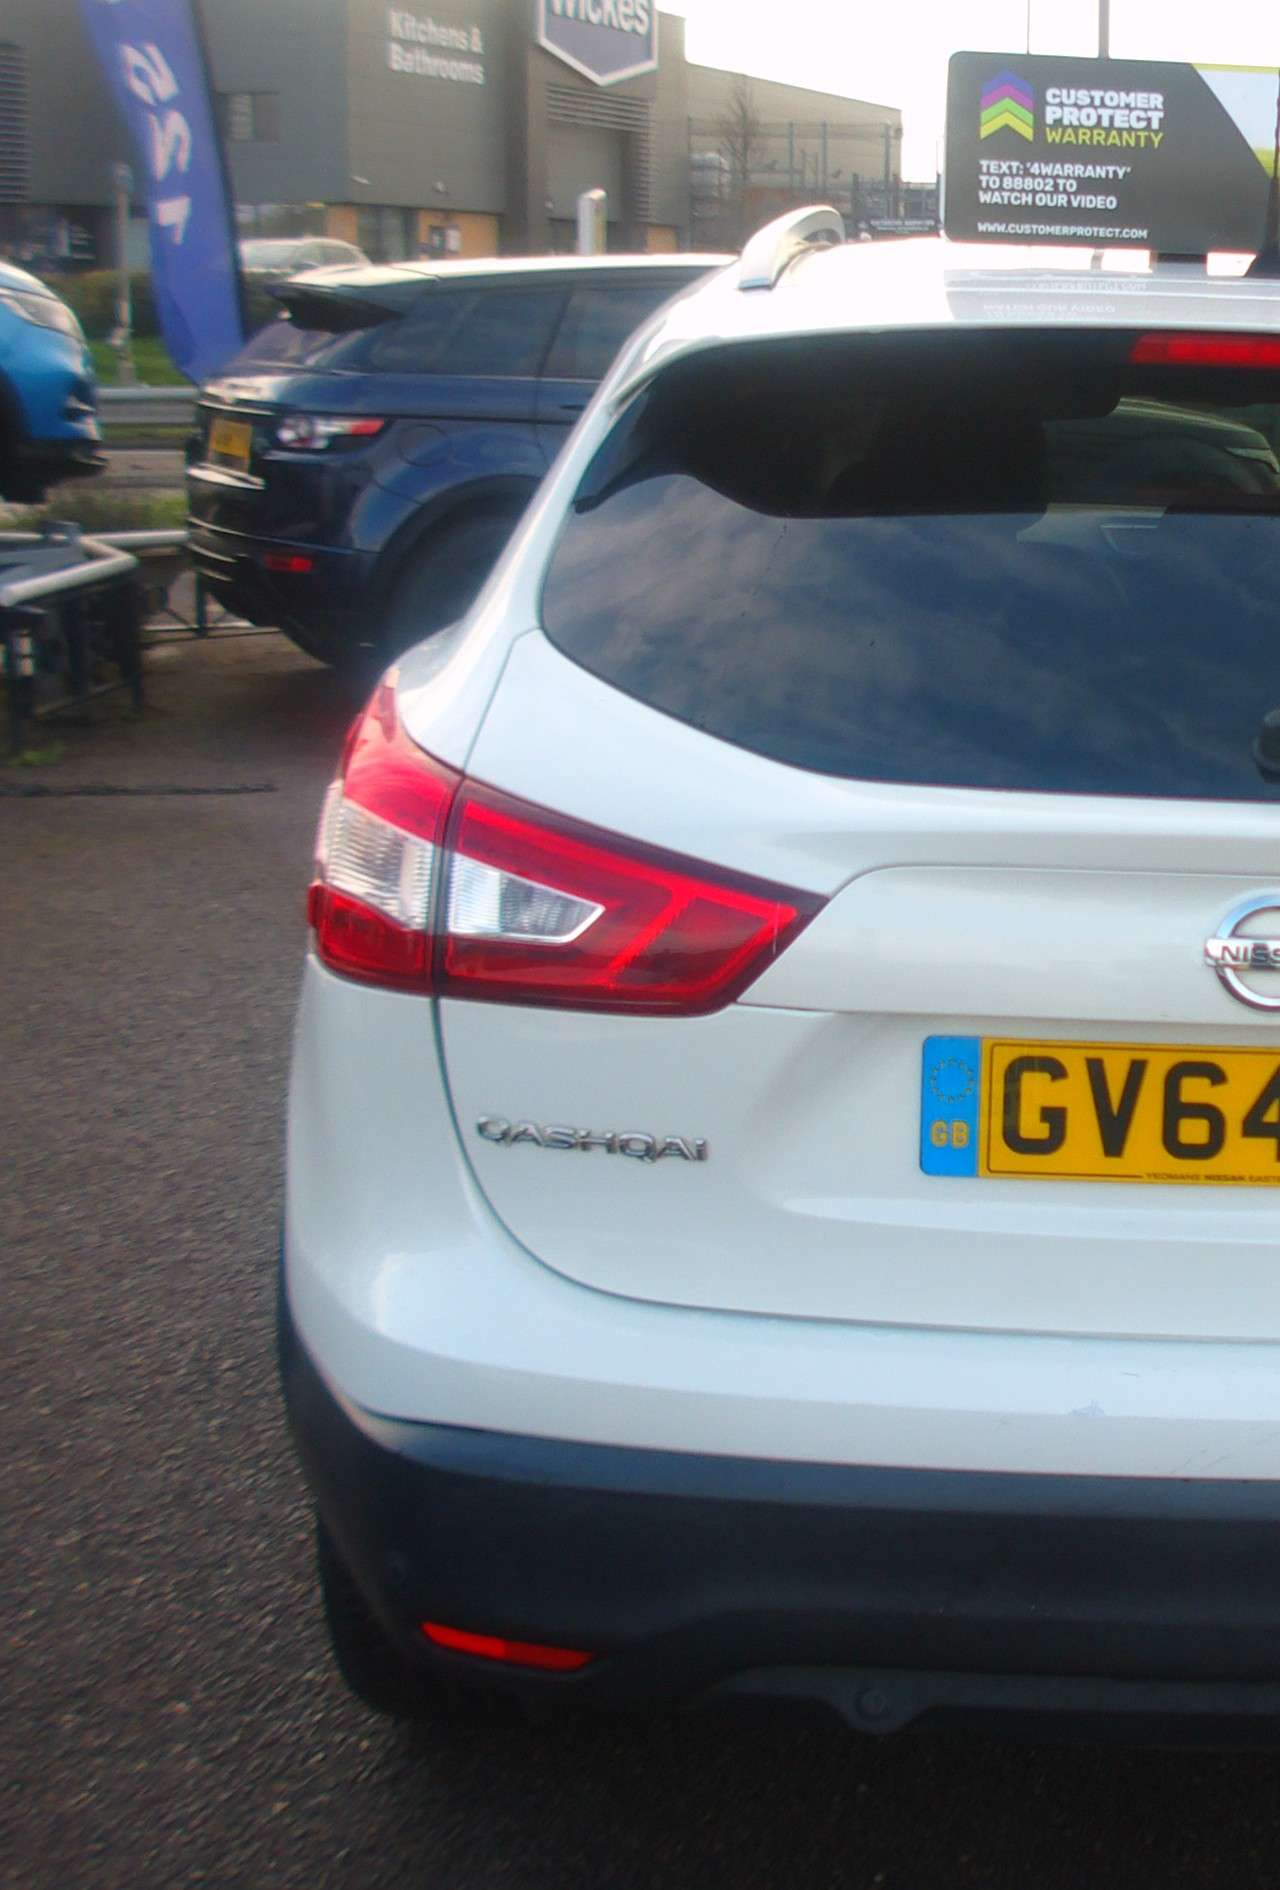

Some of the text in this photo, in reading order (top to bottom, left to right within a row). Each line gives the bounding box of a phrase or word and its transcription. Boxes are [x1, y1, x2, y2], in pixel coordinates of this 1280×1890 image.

[389, 9, 484, 53] Kitchens &
[389, 42, 485, 84] Bathrooms
[1045, 88, 1164, 109] CUSTOMER
[1045, 106, 1164, 130] PROTECT
[1045, 127, 1164, 149] WARRANTY
[979, 160, 1024, 175] TEXT:
[979, 176, 1078, 193] TO 88802 TO
[978, 190, 1118, 210] WATCH OUR VIDEO
[977, 222, 1149, 240] WWW.CUSTOMERPROTECT.COM
[476, 1115, 709, 1163] QASHQAI
[930, 1119, 970, 1149] GB
